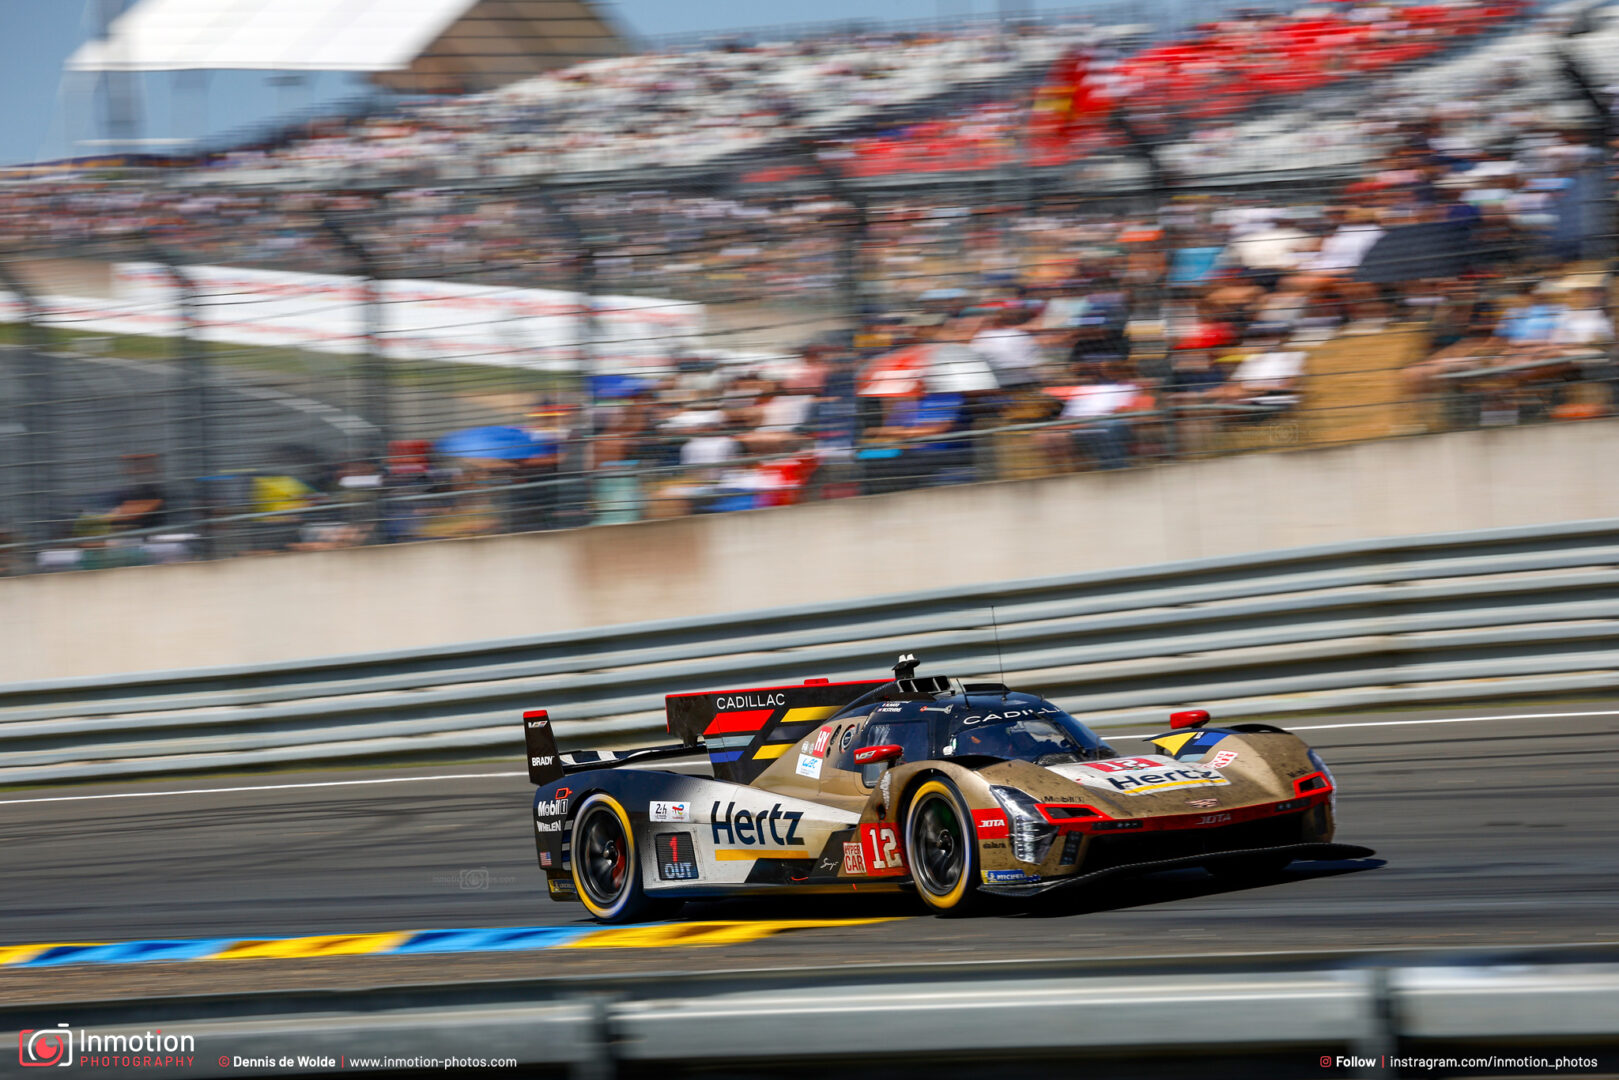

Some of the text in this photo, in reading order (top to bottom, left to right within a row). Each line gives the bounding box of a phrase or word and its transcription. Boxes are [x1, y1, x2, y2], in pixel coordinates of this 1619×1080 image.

[716, 693, 785, 710] CADILLAC
[814, 730, 831, 752] HY
[531, 756, 553, 767] BRADY
[1107, 770, 1221, 791] Hertz
[537, 799, 560, 817] Mobil
[536, 820, 561, 832] WHELEN
[710, 801, 806, 846] Hertz
[978, 819, 1005, 828] JOTA
[1194, 813, 1232, 825] JOTA
[669, 835, 679, 863] 1
[844, 845, 861, 855] HYPER
[868, 828, 903, 869] 12
[664, 862, 692, 879] OUT
[845, 855, 864, 871] CAR
